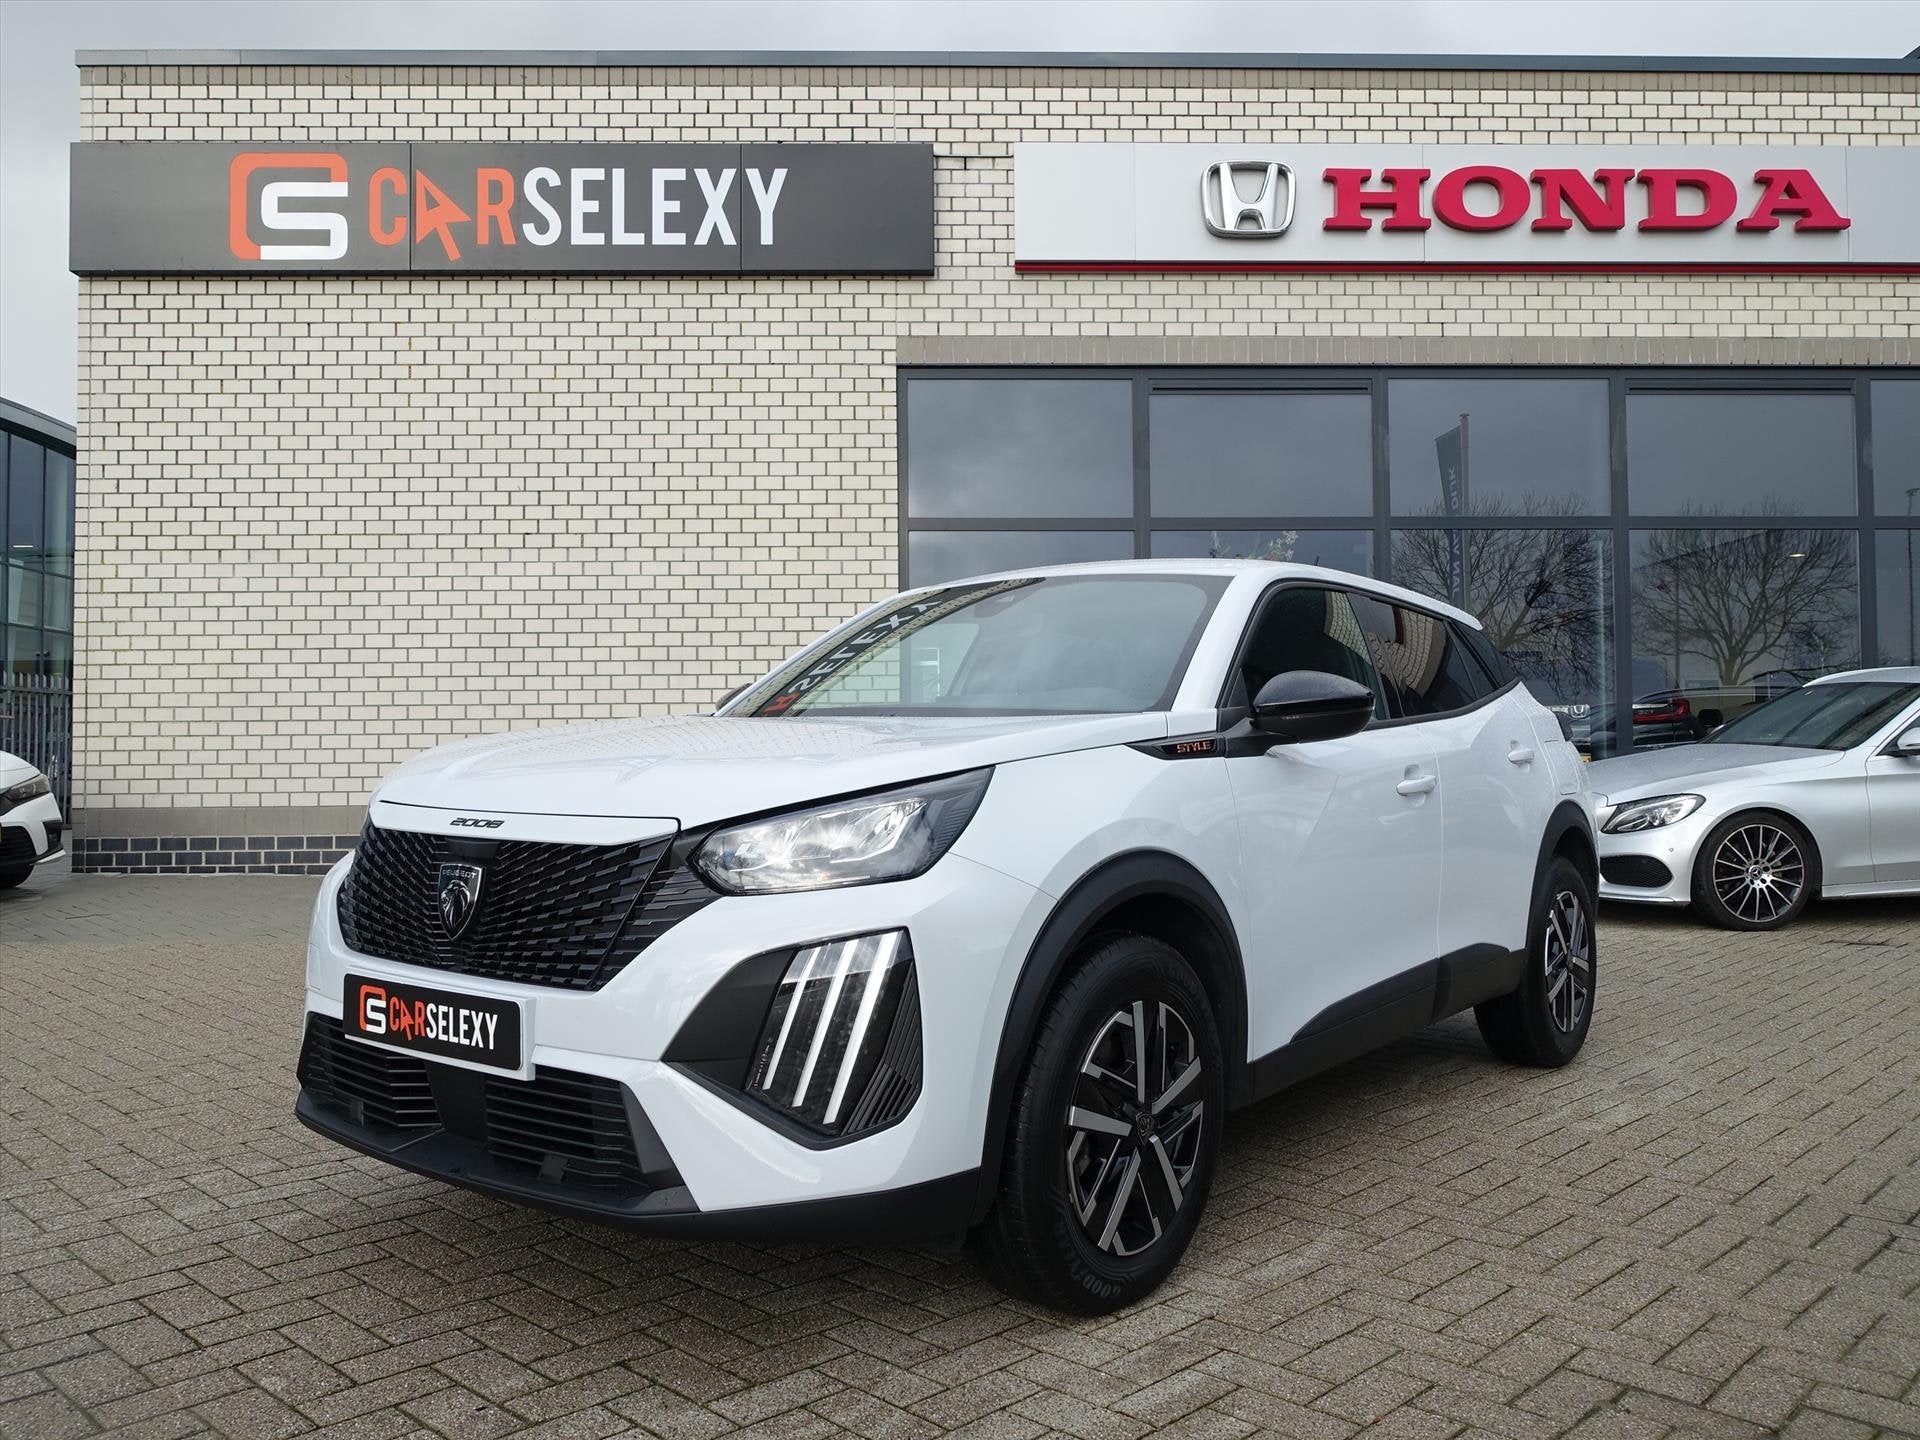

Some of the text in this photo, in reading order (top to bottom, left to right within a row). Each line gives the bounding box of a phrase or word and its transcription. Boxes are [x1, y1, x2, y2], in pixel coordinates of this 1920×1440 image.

[368, 166, 788, 261] CARSELEXY
[1322, 165, 1851, 232] HONDA
[1177, 740, 1211, 753] STYLE
[450, 817, 505, 828] 2008
[441, 868, 478, 879] PEUGEOT
[389, 996, 498, 1050] CARSELEXY
